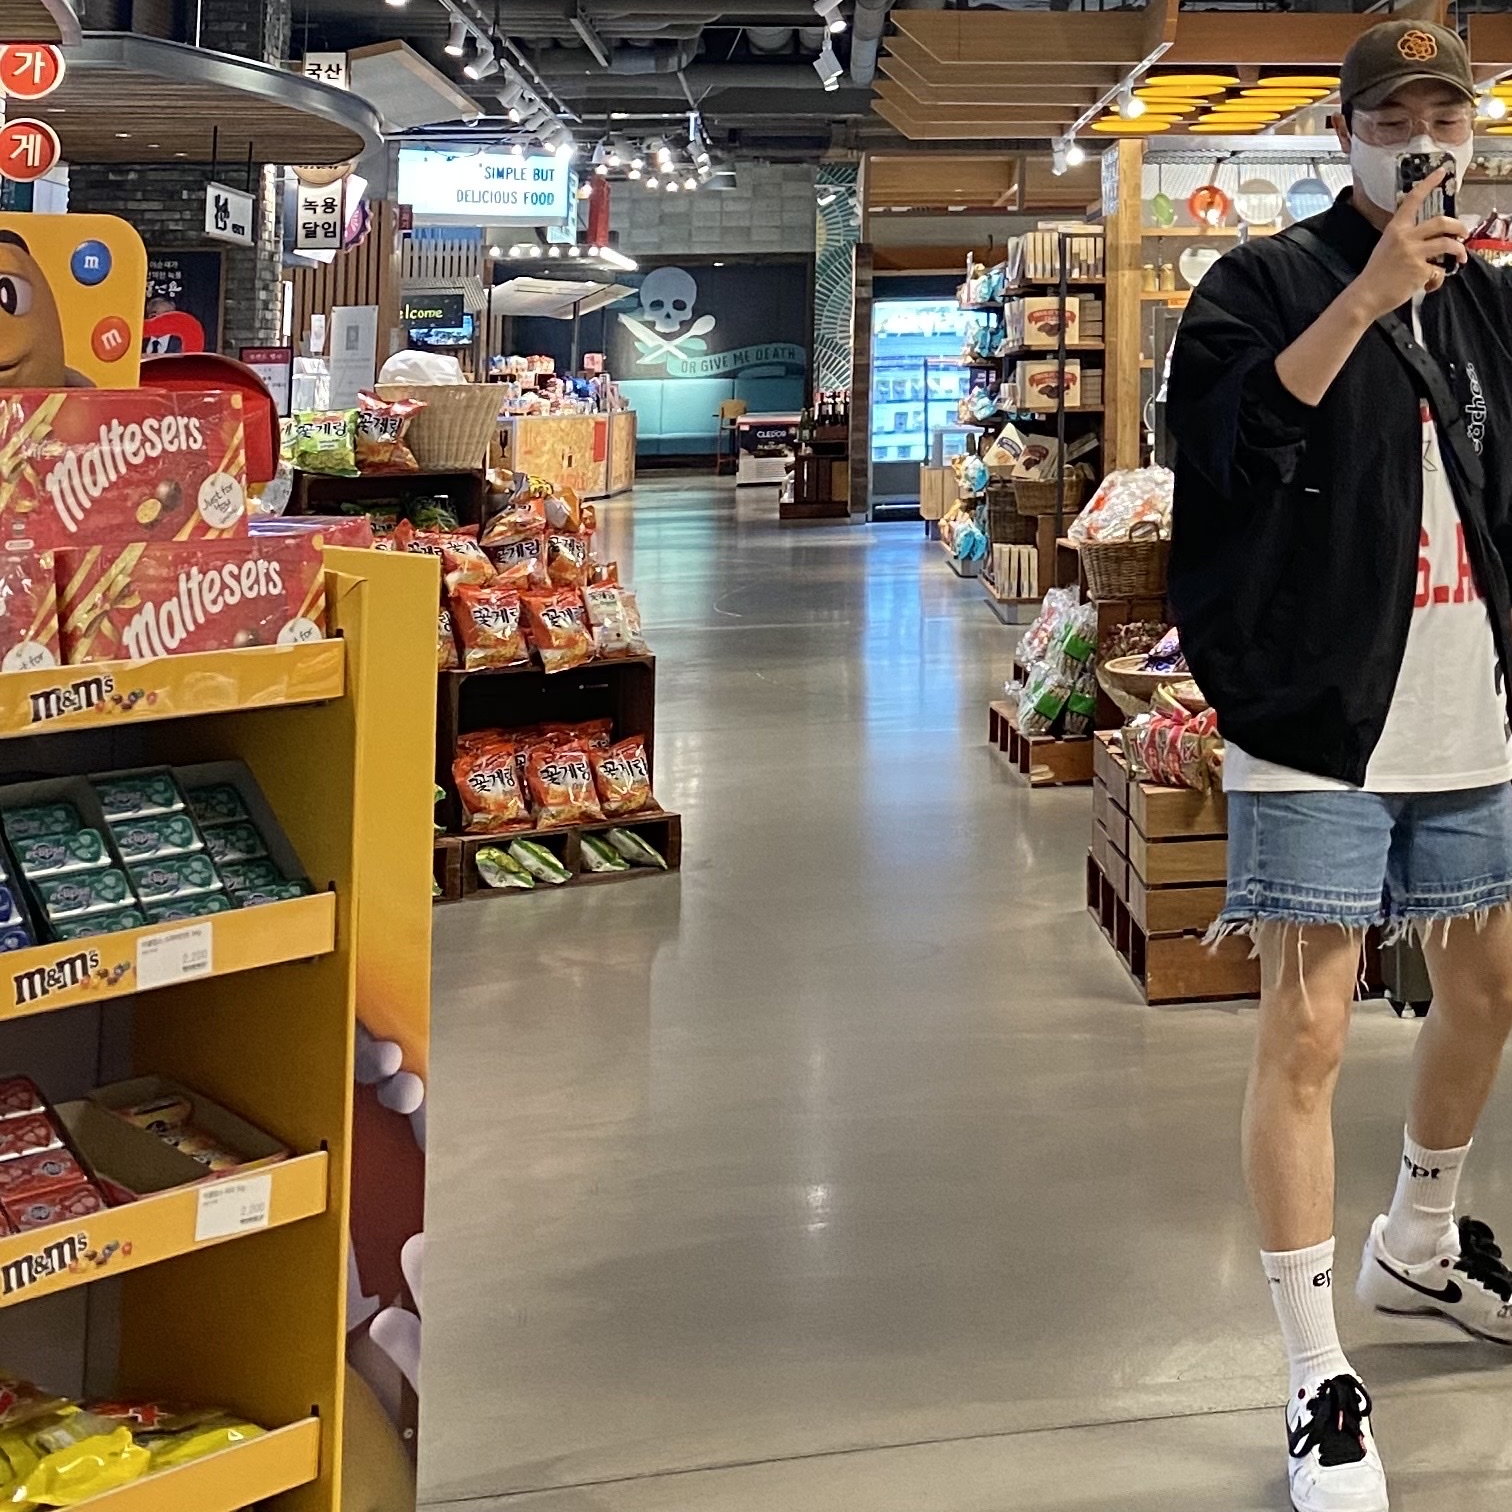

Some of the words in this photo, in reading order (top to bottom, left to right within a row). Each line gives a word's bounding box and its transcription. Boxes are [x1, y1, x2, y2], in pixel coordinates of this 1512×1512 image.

[13, 51, 46, 84] 가
[9, 133, 42, 167] 게
[484, 166, 527, 181] SIMPLE
[533, 169, 555, 181] BUT
[302, 197, 338, 214] 녹용
[456, 189, 518, 204] DELICIOUS
[523, 192, 555, 205] FOOD
[302, 221, 337, 238] 달임
[84, 255, 100, 270] m
[101, 329, 122, 350] m
[680, 359, 697, 374] OR
[700, 355, 730, 372] GIVE
[733, 350, 750, 366] ME
[755, 347, 796, 362] DEATH
[296, 421, 347, 437] 꽃게랑
[46, 416, 203, 533] Maltesers
[123, 559, 284, 660] Maltesers
[468, 766, 516, 792] 꽃게랑
[540, 761, 591, 786] 꽃게랑
